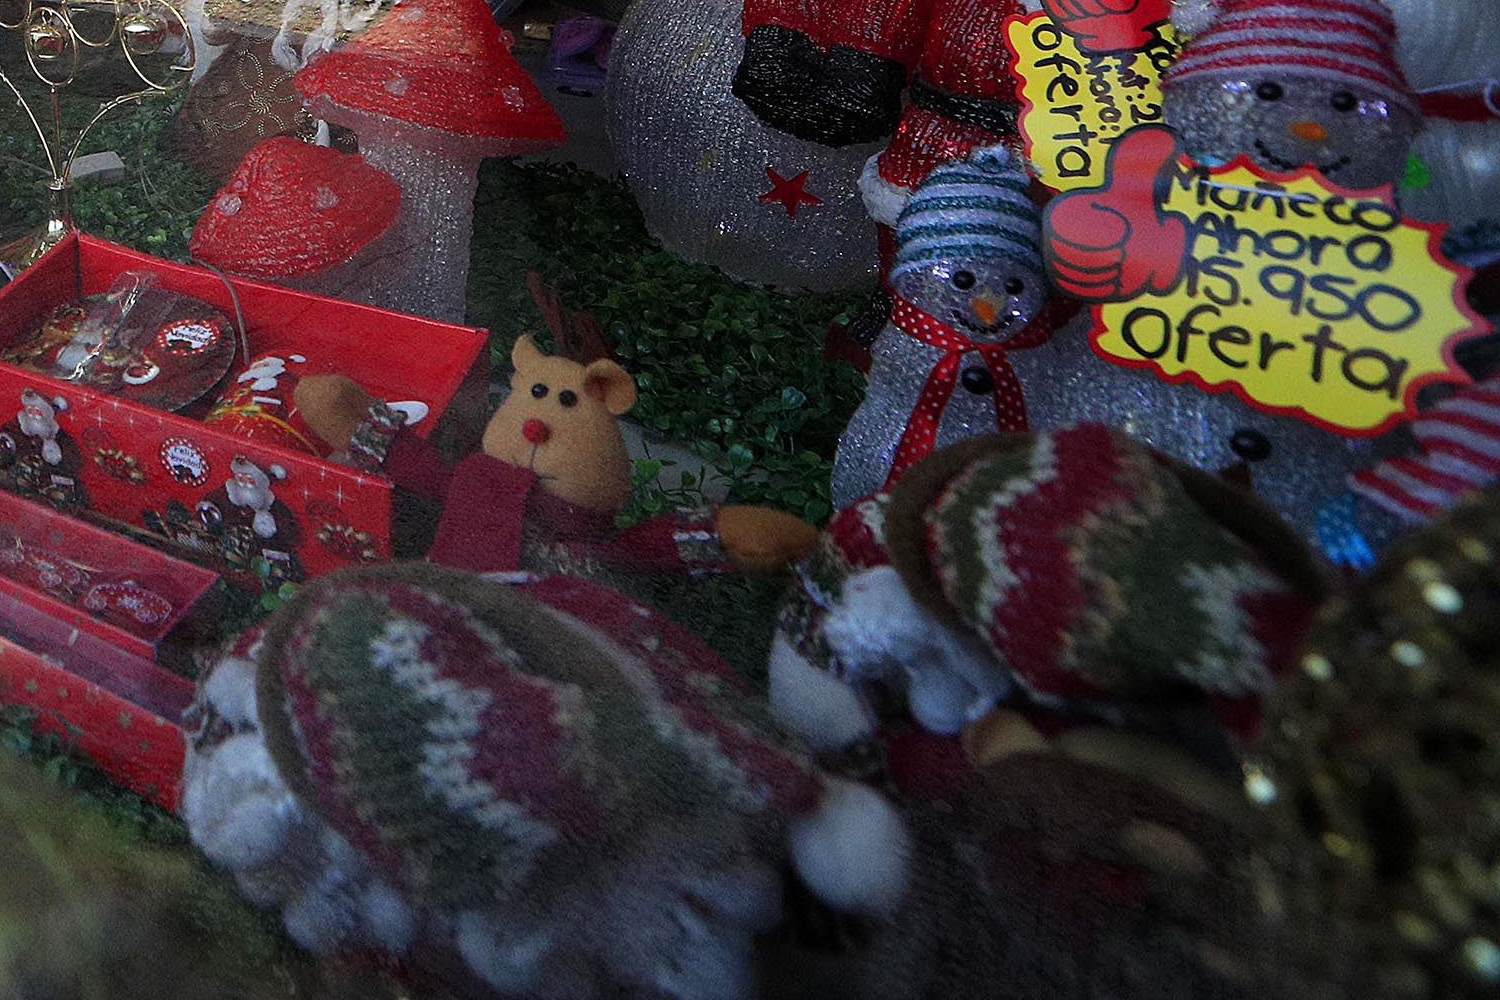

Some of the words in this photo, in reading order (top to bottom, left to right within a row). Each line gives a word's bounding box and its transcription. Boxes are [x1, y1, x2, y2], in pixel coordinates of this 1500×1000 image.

[1031, 23, 1098, 178] oferta
[1188, 211, 1394, 273] Ahora
[1185, 254, 1423, 333] 15.950
